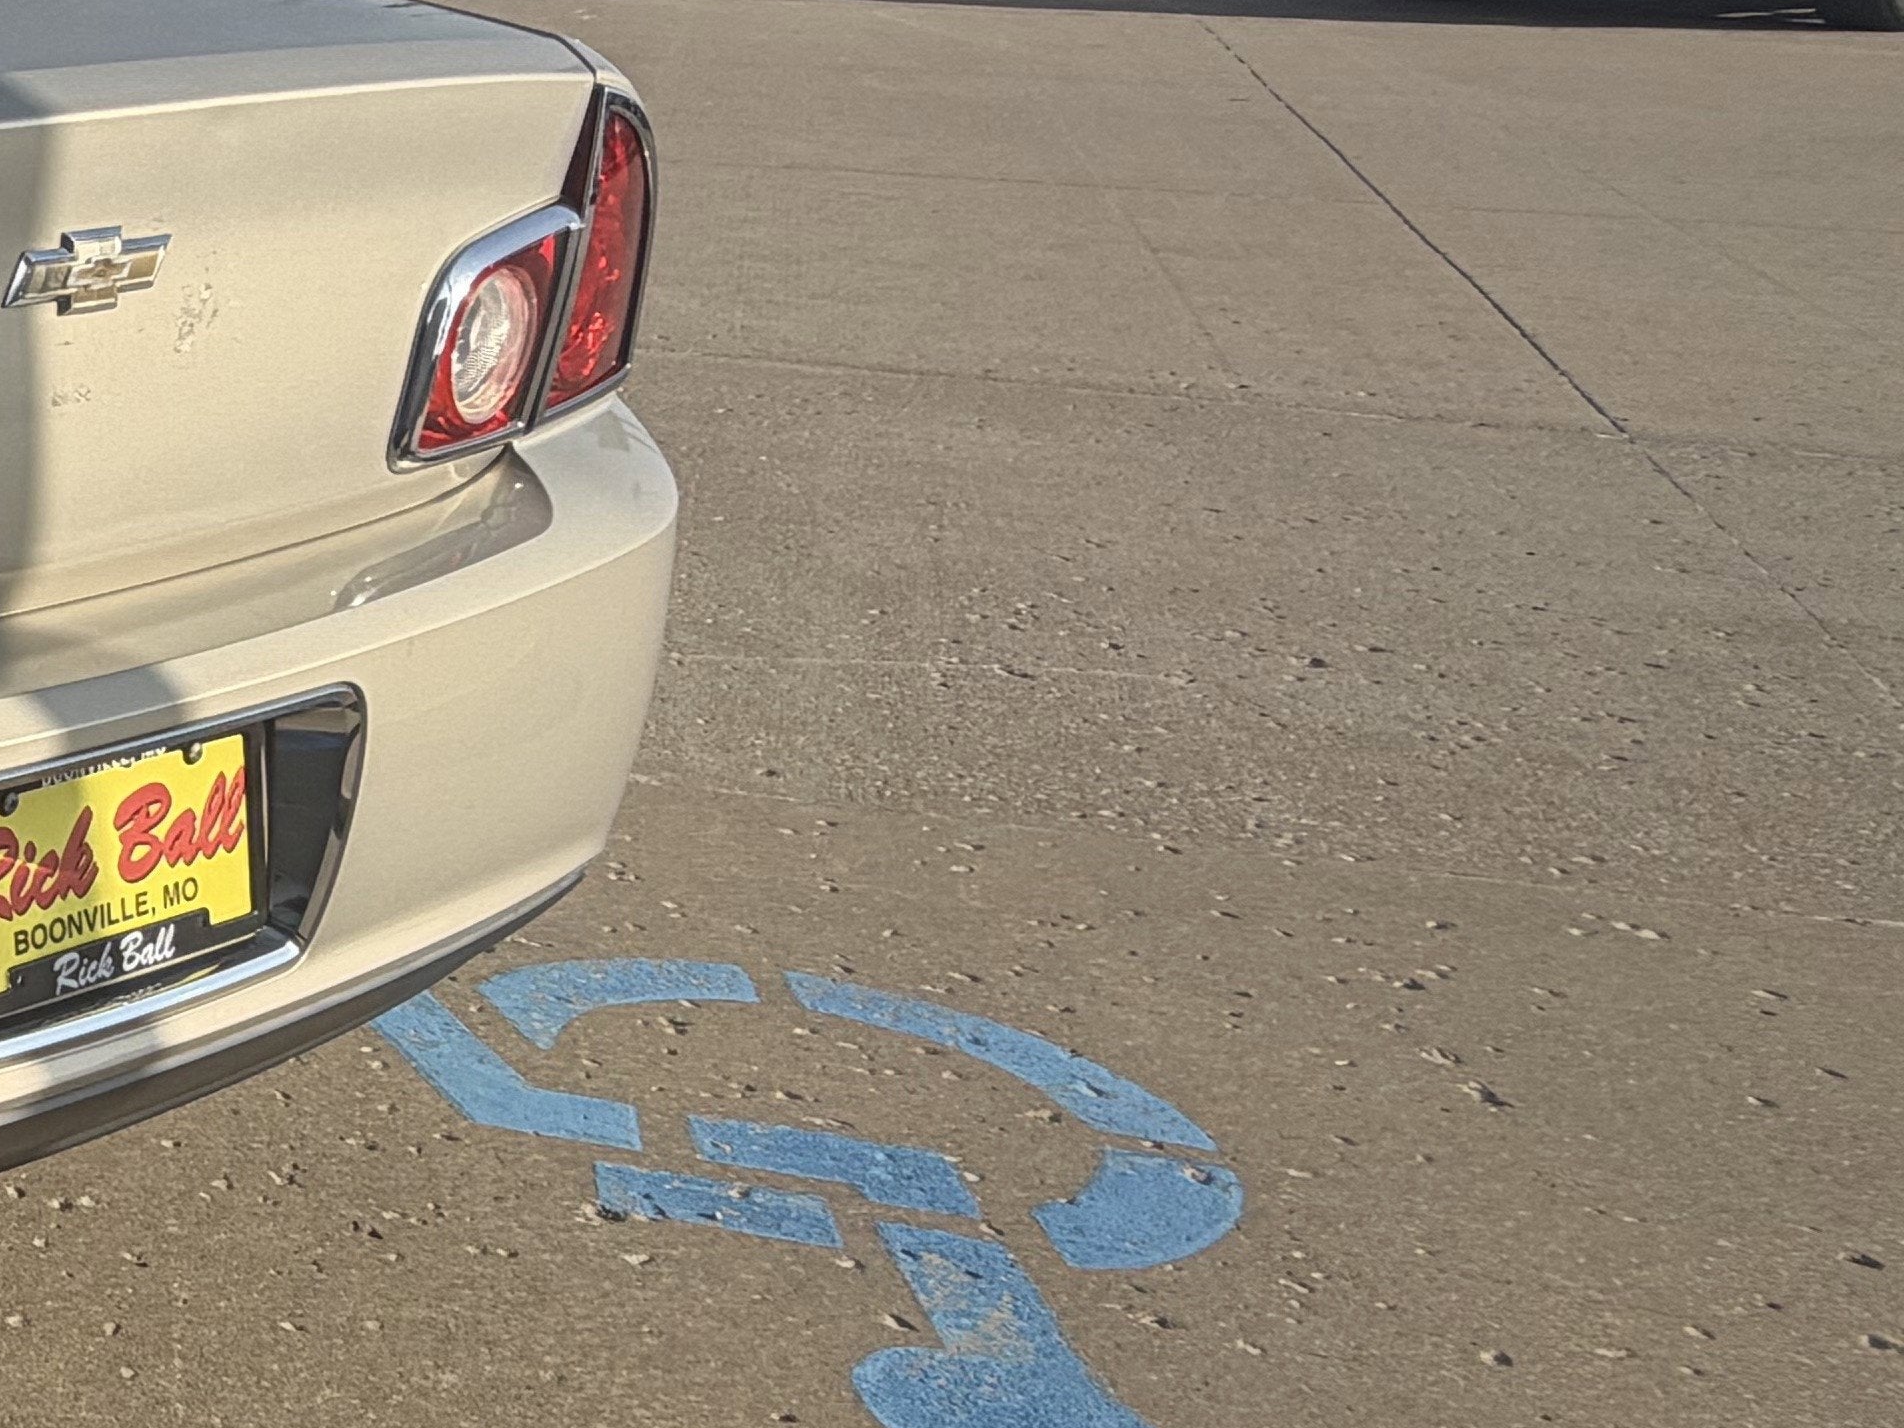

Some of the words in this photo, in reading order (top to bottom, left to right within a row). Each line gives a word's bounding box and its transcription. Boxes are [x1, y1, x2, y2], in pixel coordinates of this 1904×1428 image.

[113, 764, 245, 884] Ball
[14, 890, 157, 956] BOONVILLE,
[163, 875, 200, 911] MO
[53, 941, 115, 996] Rick
[119, 923, 176, 973] Ball
